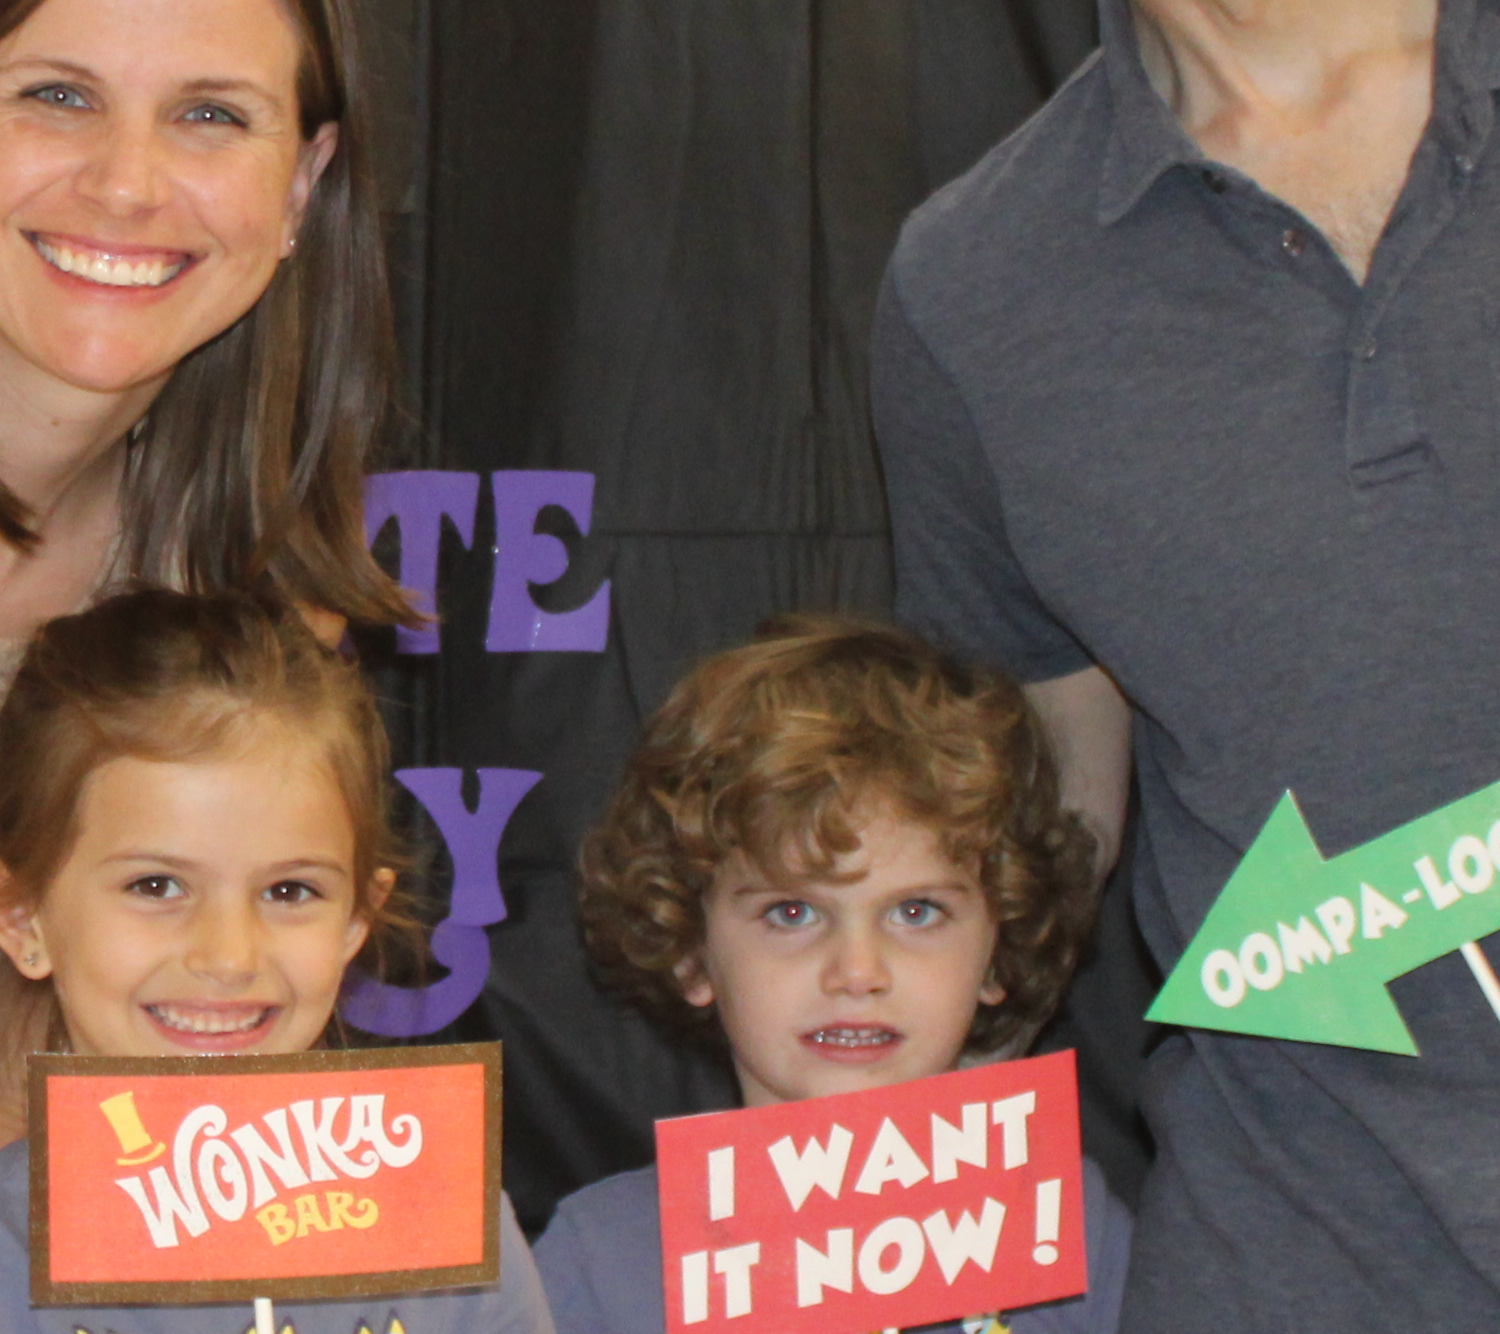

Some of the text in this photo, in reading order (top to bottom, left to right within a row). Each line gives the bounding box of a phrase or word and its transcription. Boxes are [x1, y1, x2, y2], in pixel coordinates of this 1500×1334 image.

[115, 1094, 423, 1249] WONKA
[707, 1090, 1036, 1222] I WANT
[255, 1191, 380, 1246] BAR
[681, 1241, 760, 1325] IT
